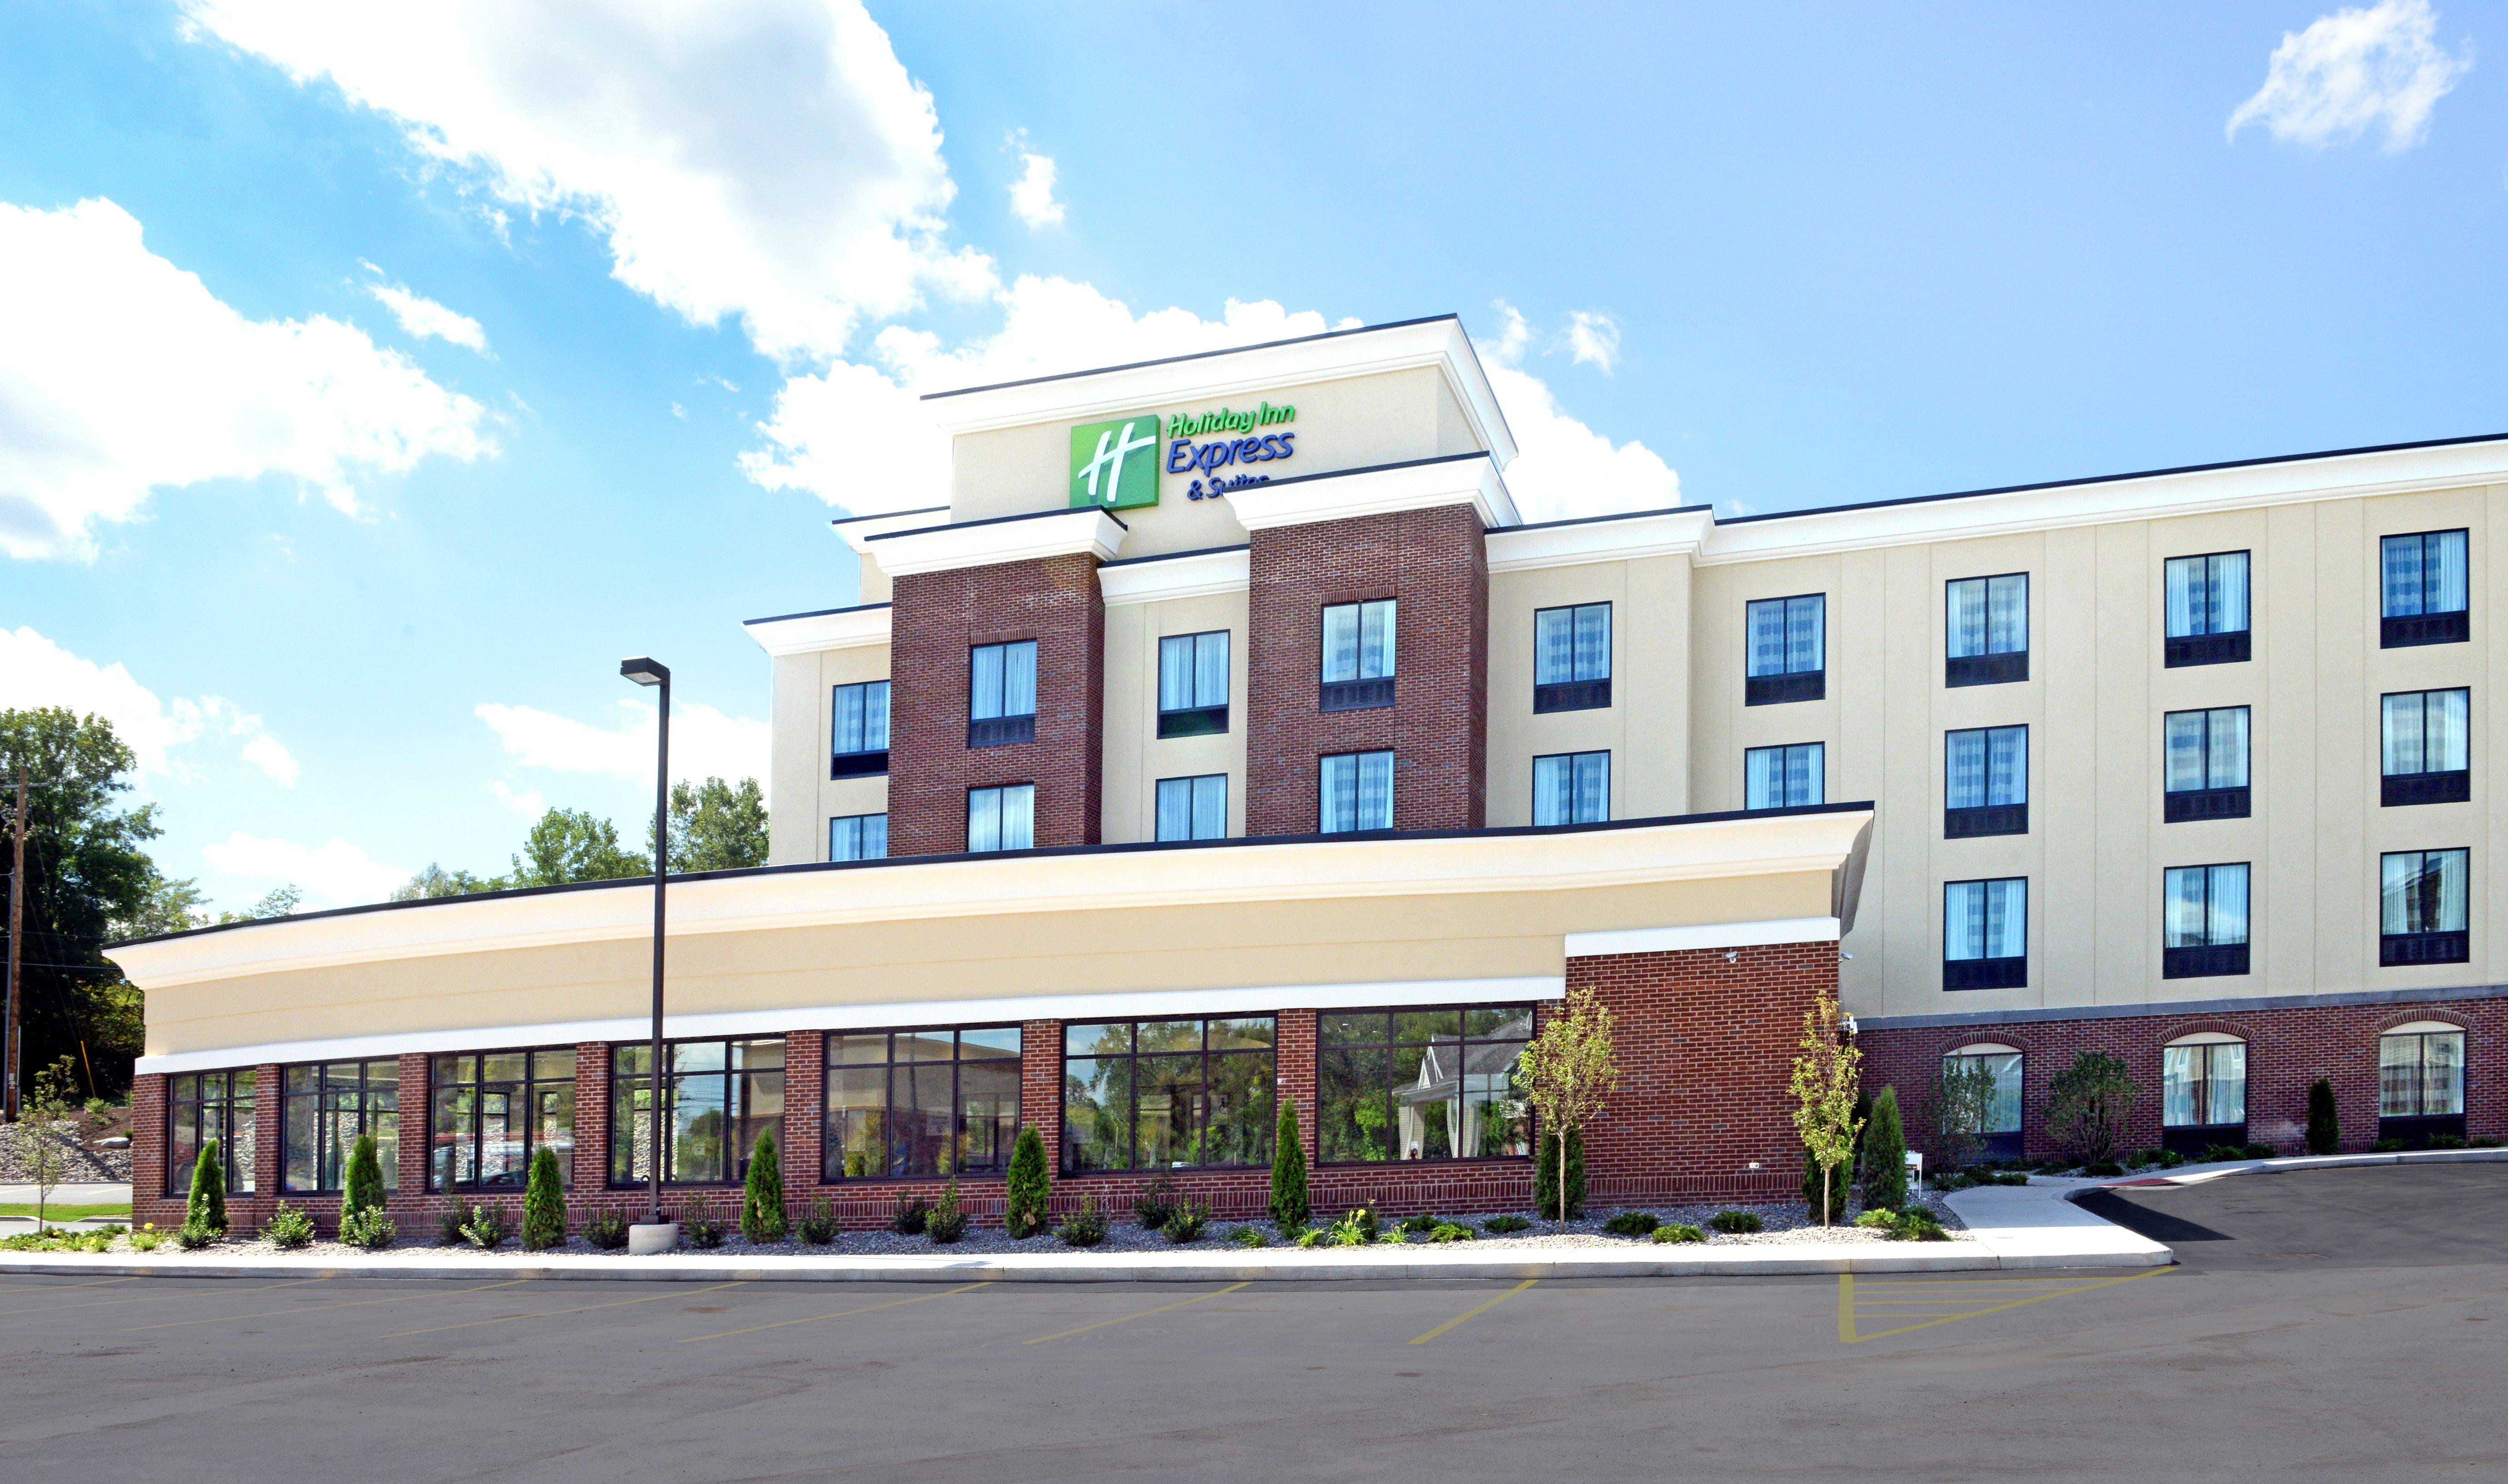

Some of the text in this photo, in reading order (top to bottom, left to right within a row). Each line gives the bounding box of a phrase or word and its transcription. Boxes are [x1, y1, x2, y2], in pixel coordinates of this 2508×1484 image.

[1167, 401, 1295, 439] Holiday Inn
[1078, 422, 1156, 501] H
[1166, 432, 1295, 477] Express
[1187, 480, 1203, 501] &
